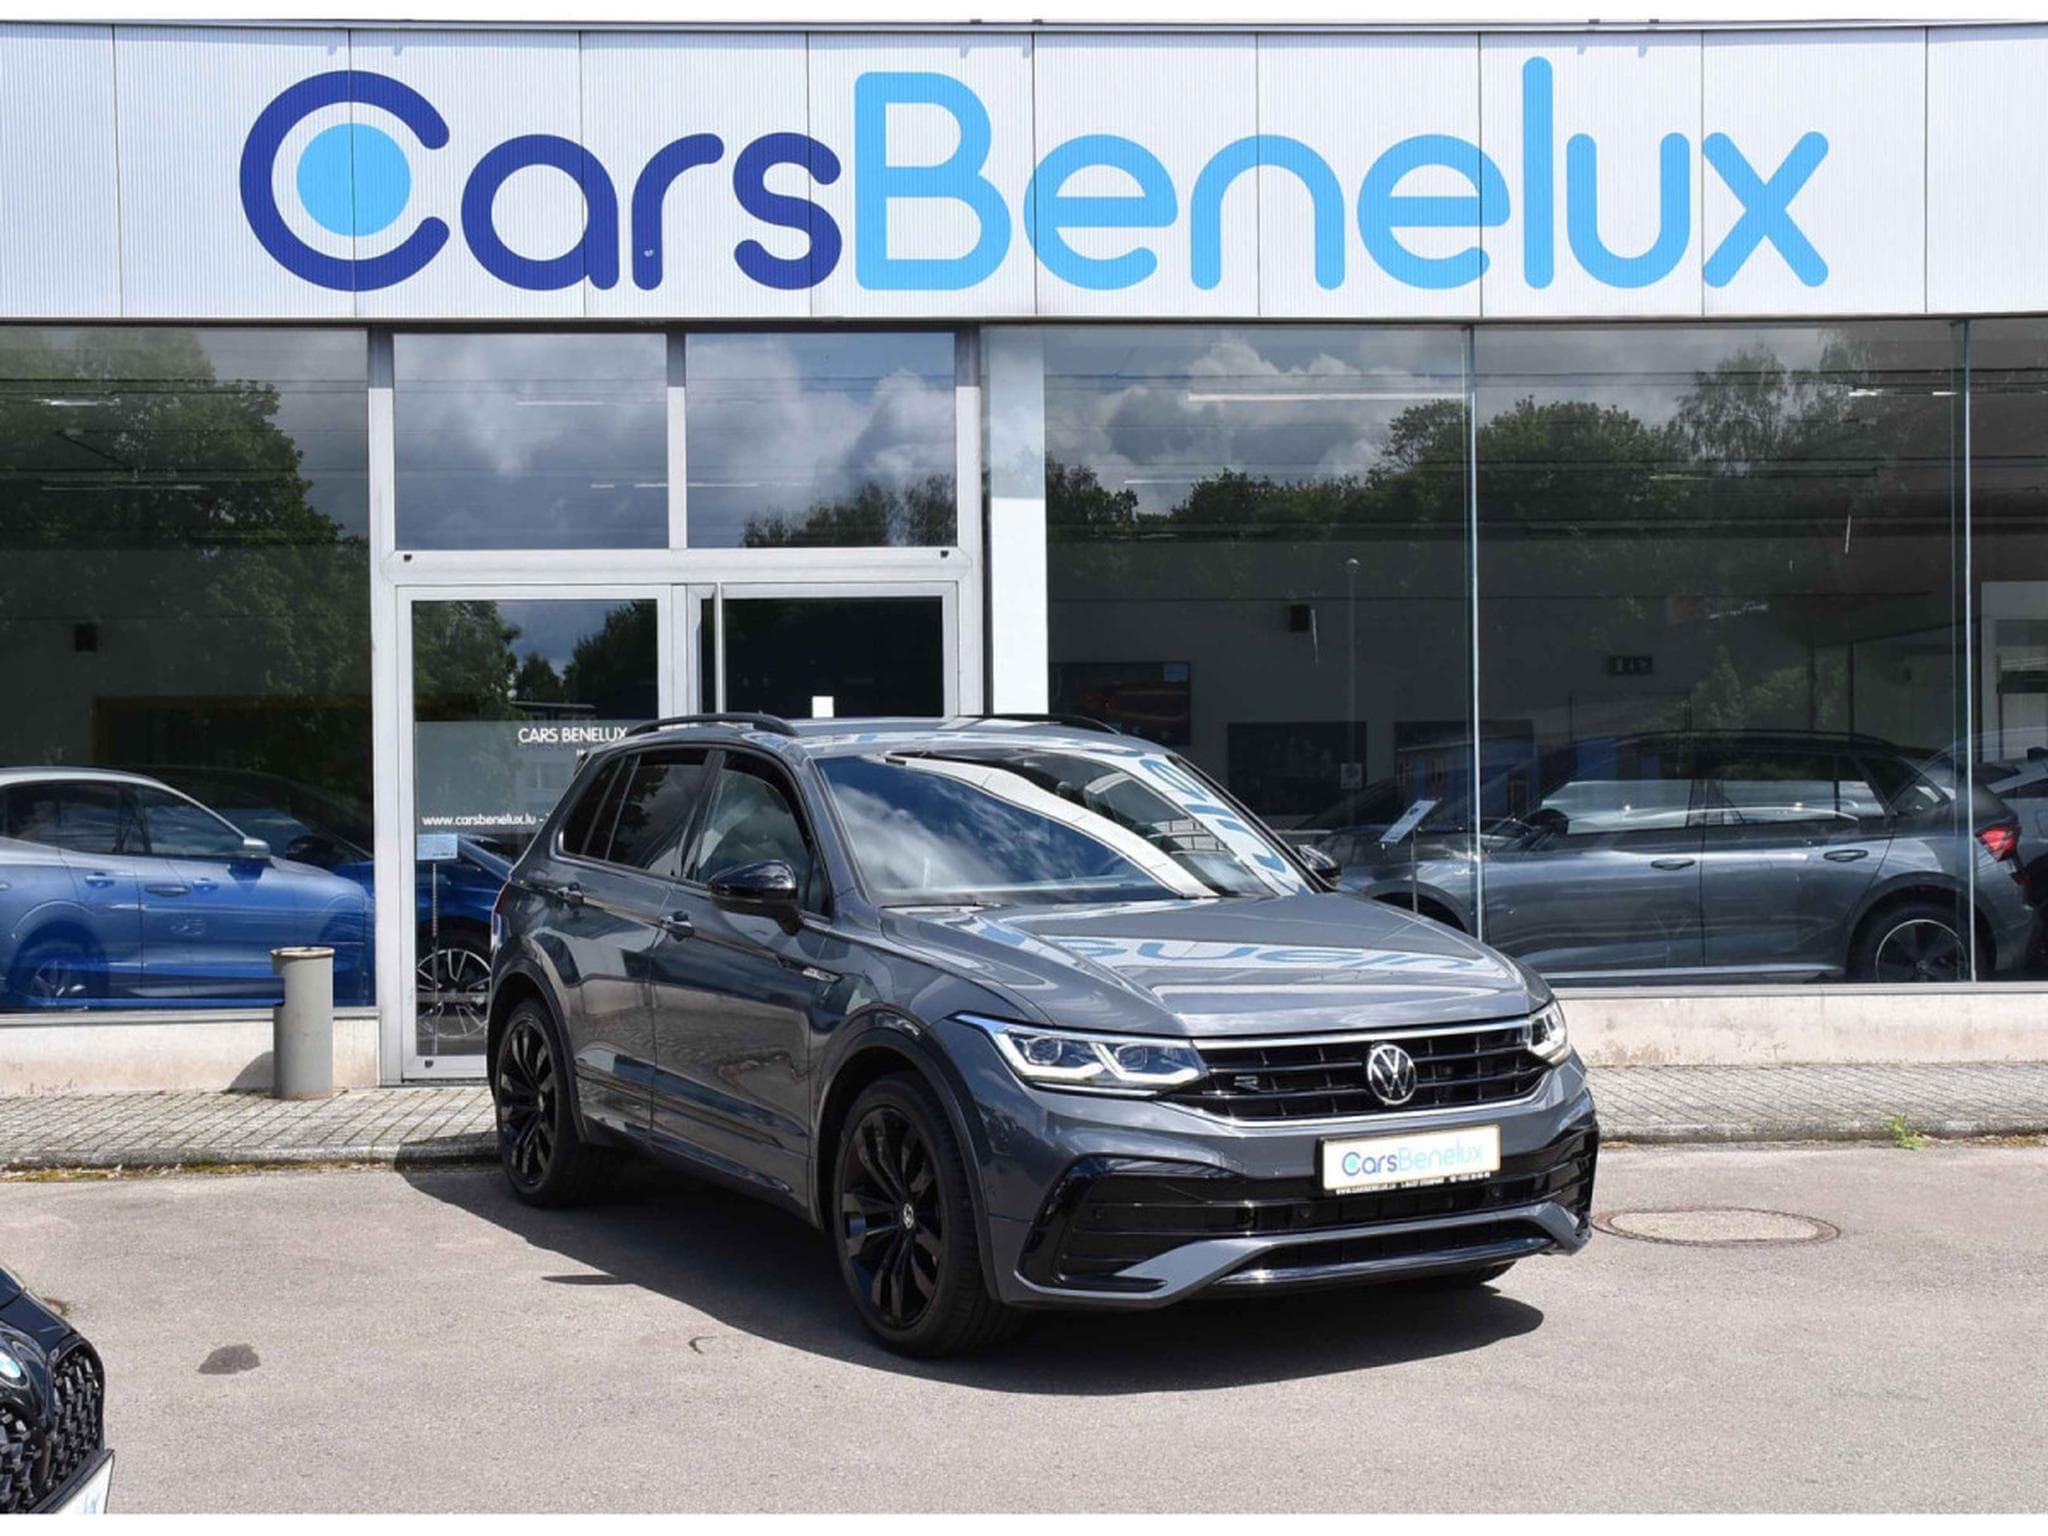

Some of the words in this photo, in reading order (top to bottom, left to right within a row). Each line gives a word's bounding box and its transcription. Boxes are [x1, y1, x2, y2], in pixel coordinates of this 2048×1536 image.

[240, 56, 1830, 292] CarsBenelux
[518, 728, 558, 744] CARS
[561, 726, 628, 743] BENELUX
[422, 813, 536, 826] www.carsbenelux.lu
[1341, 1140, 1483, 1177] CarsBenelux
